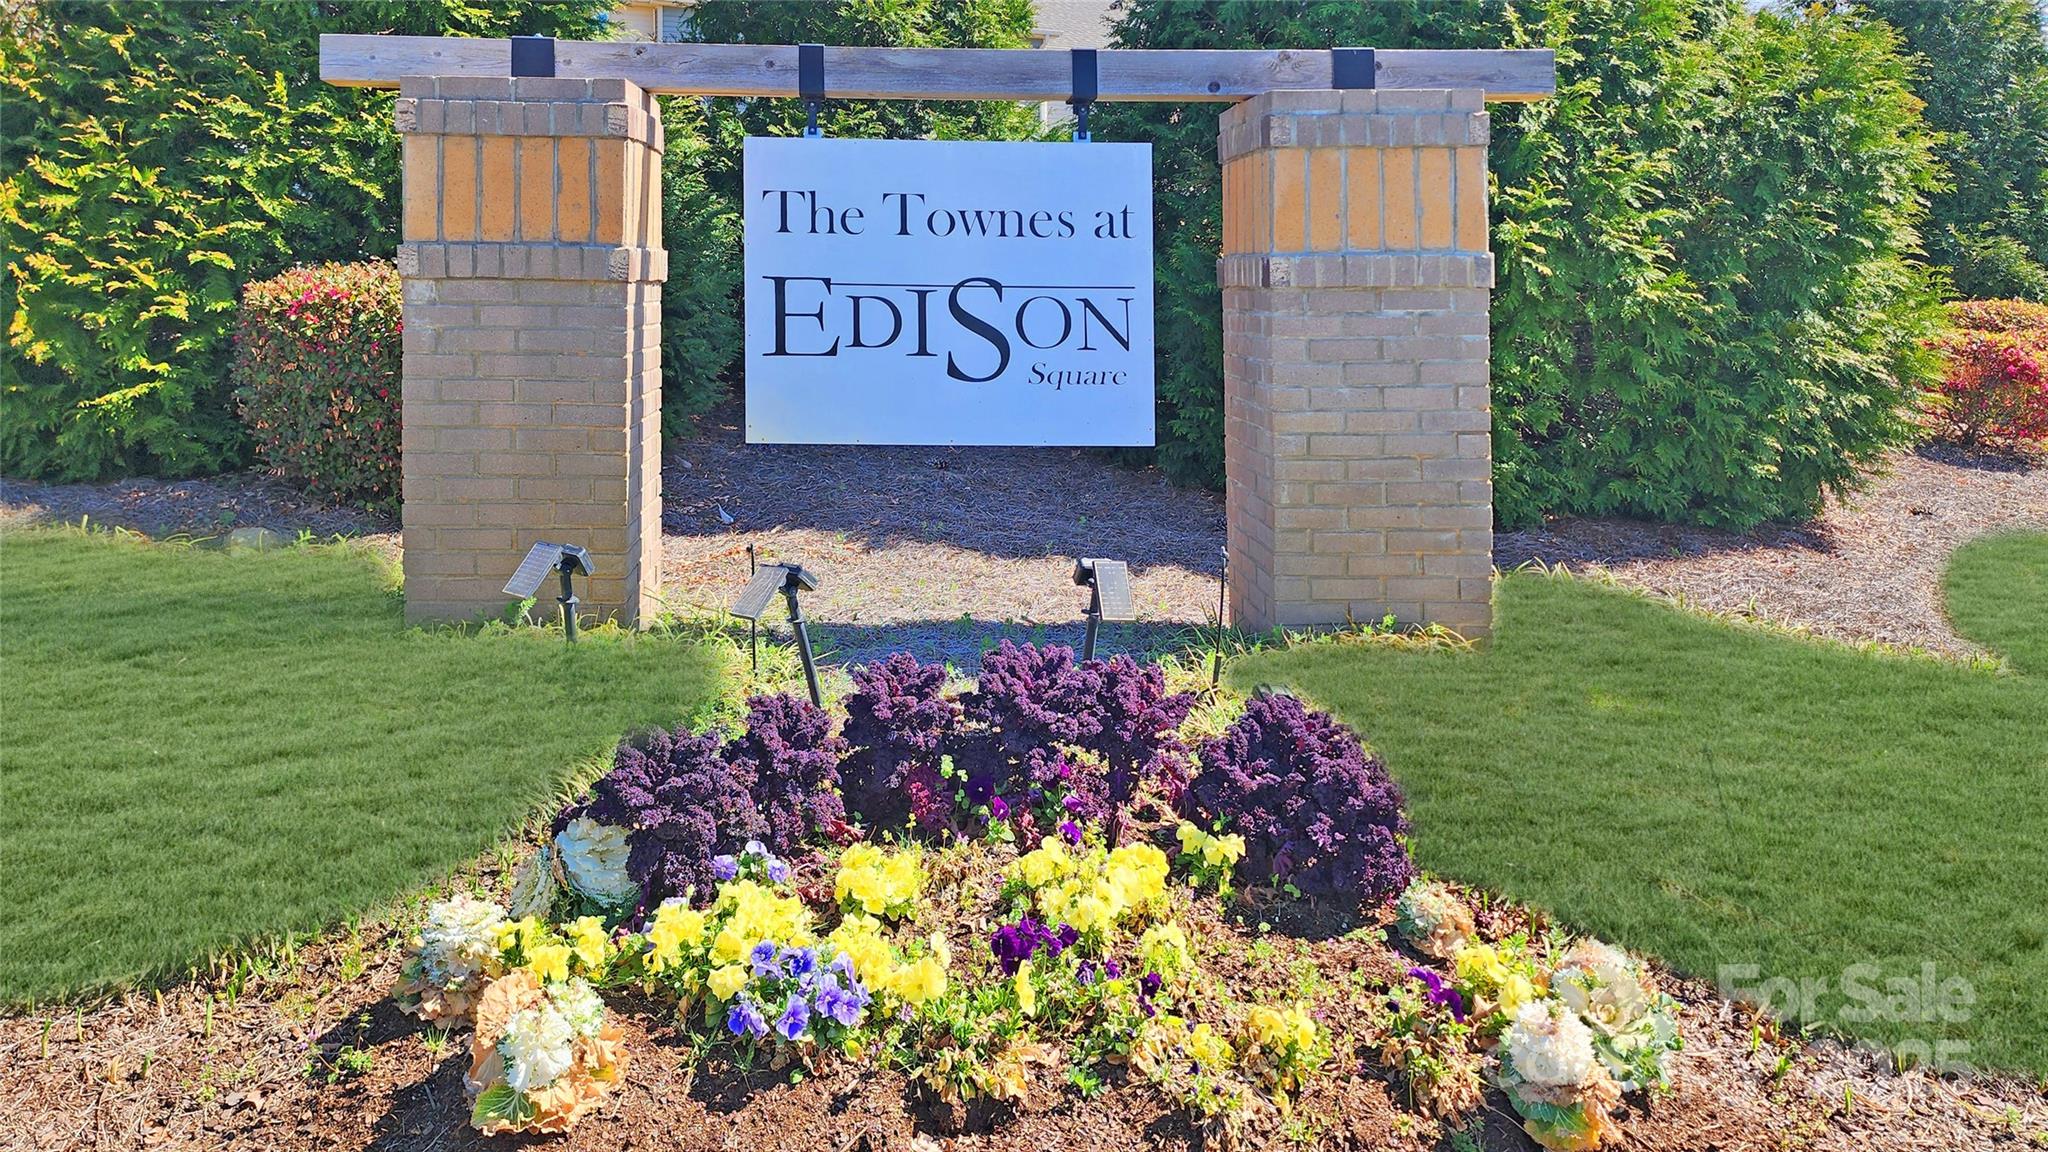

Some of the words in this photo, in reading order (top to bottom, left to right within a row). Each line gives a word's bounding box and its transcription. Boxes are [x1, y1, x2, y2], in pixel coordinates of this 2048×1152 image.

[762, 189, 865, 236] The
[882, 192, 1076, 239] Townes
[1094, 203, 1137, 240] at
[762, 275, 1136, 383] EDISON
[1027, 361, 1128, 391] Square
